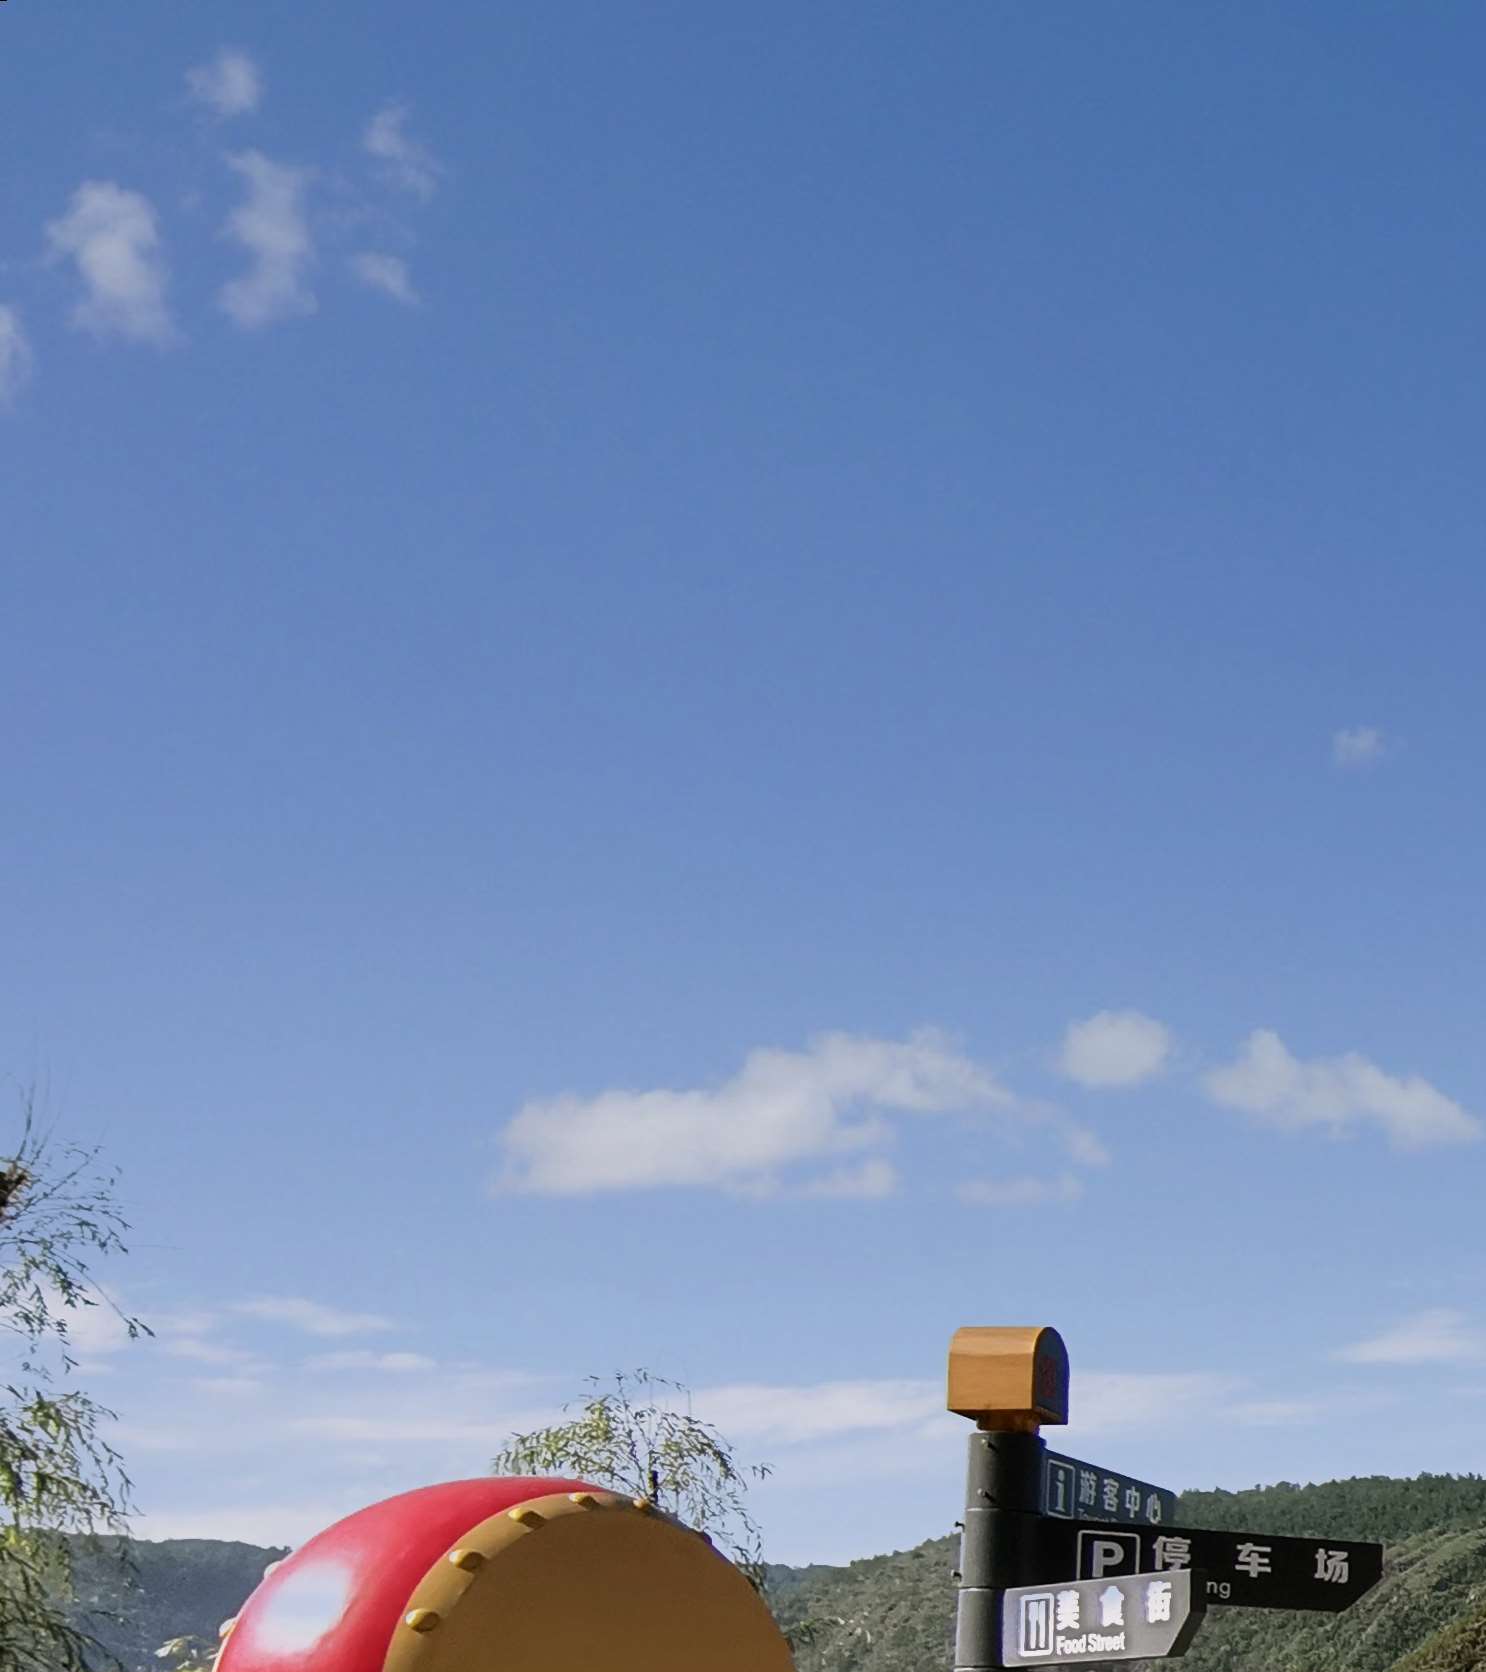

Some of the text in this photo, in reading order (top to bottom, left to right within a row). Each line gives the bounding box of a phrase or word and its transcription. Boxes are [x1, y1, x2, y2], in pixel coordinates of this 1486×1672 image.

[1079, 1469, 1161, 1524] 游客中心
[1092, 1540, 1124, 1577] P
[1152, 1535, 1349, 1583] 停车场
[1056, 1580, 1172, 1630] 美食街
[1056, 1631, 1125, 1655] Food Street
